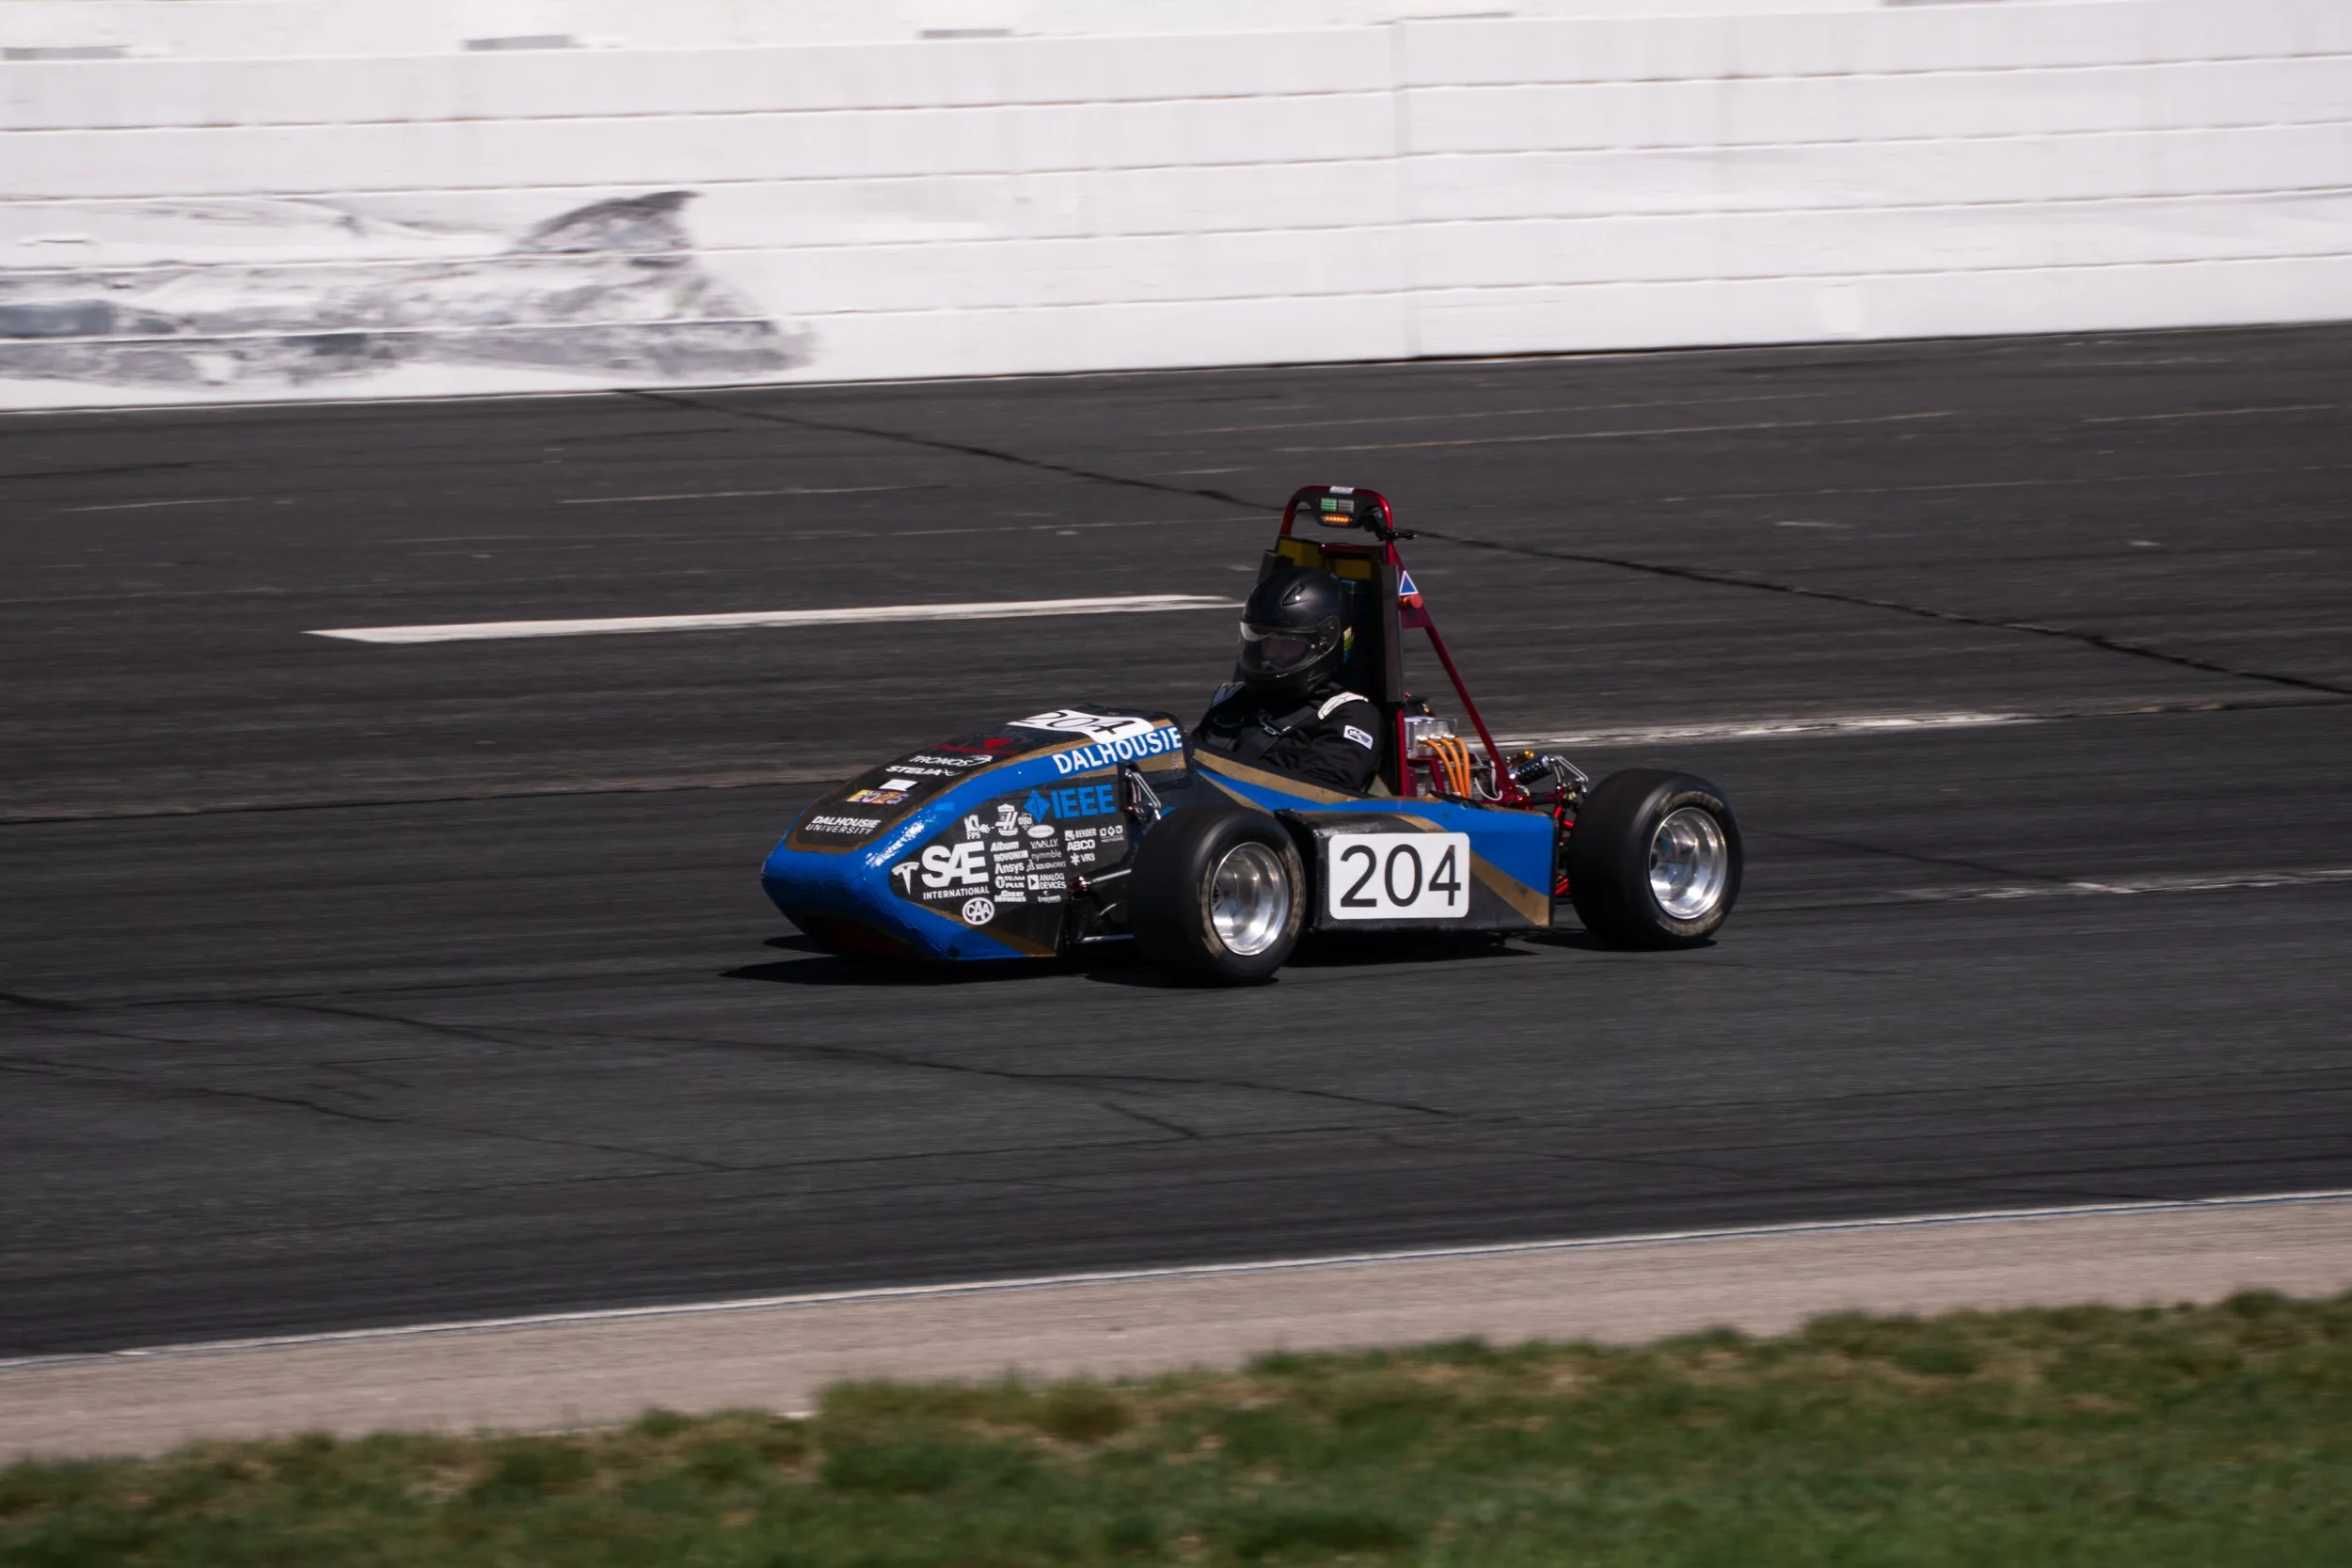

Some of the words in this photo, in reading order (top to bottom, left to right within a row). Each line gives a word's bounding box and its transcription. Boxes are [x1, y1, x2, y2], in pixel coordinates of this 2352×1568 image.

[1019, 711, 1137, 735] 204
[1052, 726, 1183, 774] DALHOUSIE
[909, 755, 974, 767] TRONOS
[885, 766, 942, 776] STELIA
[1049, 784, 1117, 819] IEEE
[805, 823, 874, 834] UNIVERSITY
[811, 816, 882, 829] DALHOUSIE
[1074, 828, 1097, 838] BENDER
[1067, 839, 1095, 851] ABCO
[921, 841, 989, 888] SAE
[1081, 853, 1095, 863] VR3
[1040, 873, 1065, 881] ANALOG
[1340, 844, 1461, 908] 204
[923, 886, 990, 900] INTERNATIONAL
[966, 900, 991, 922] CAA
